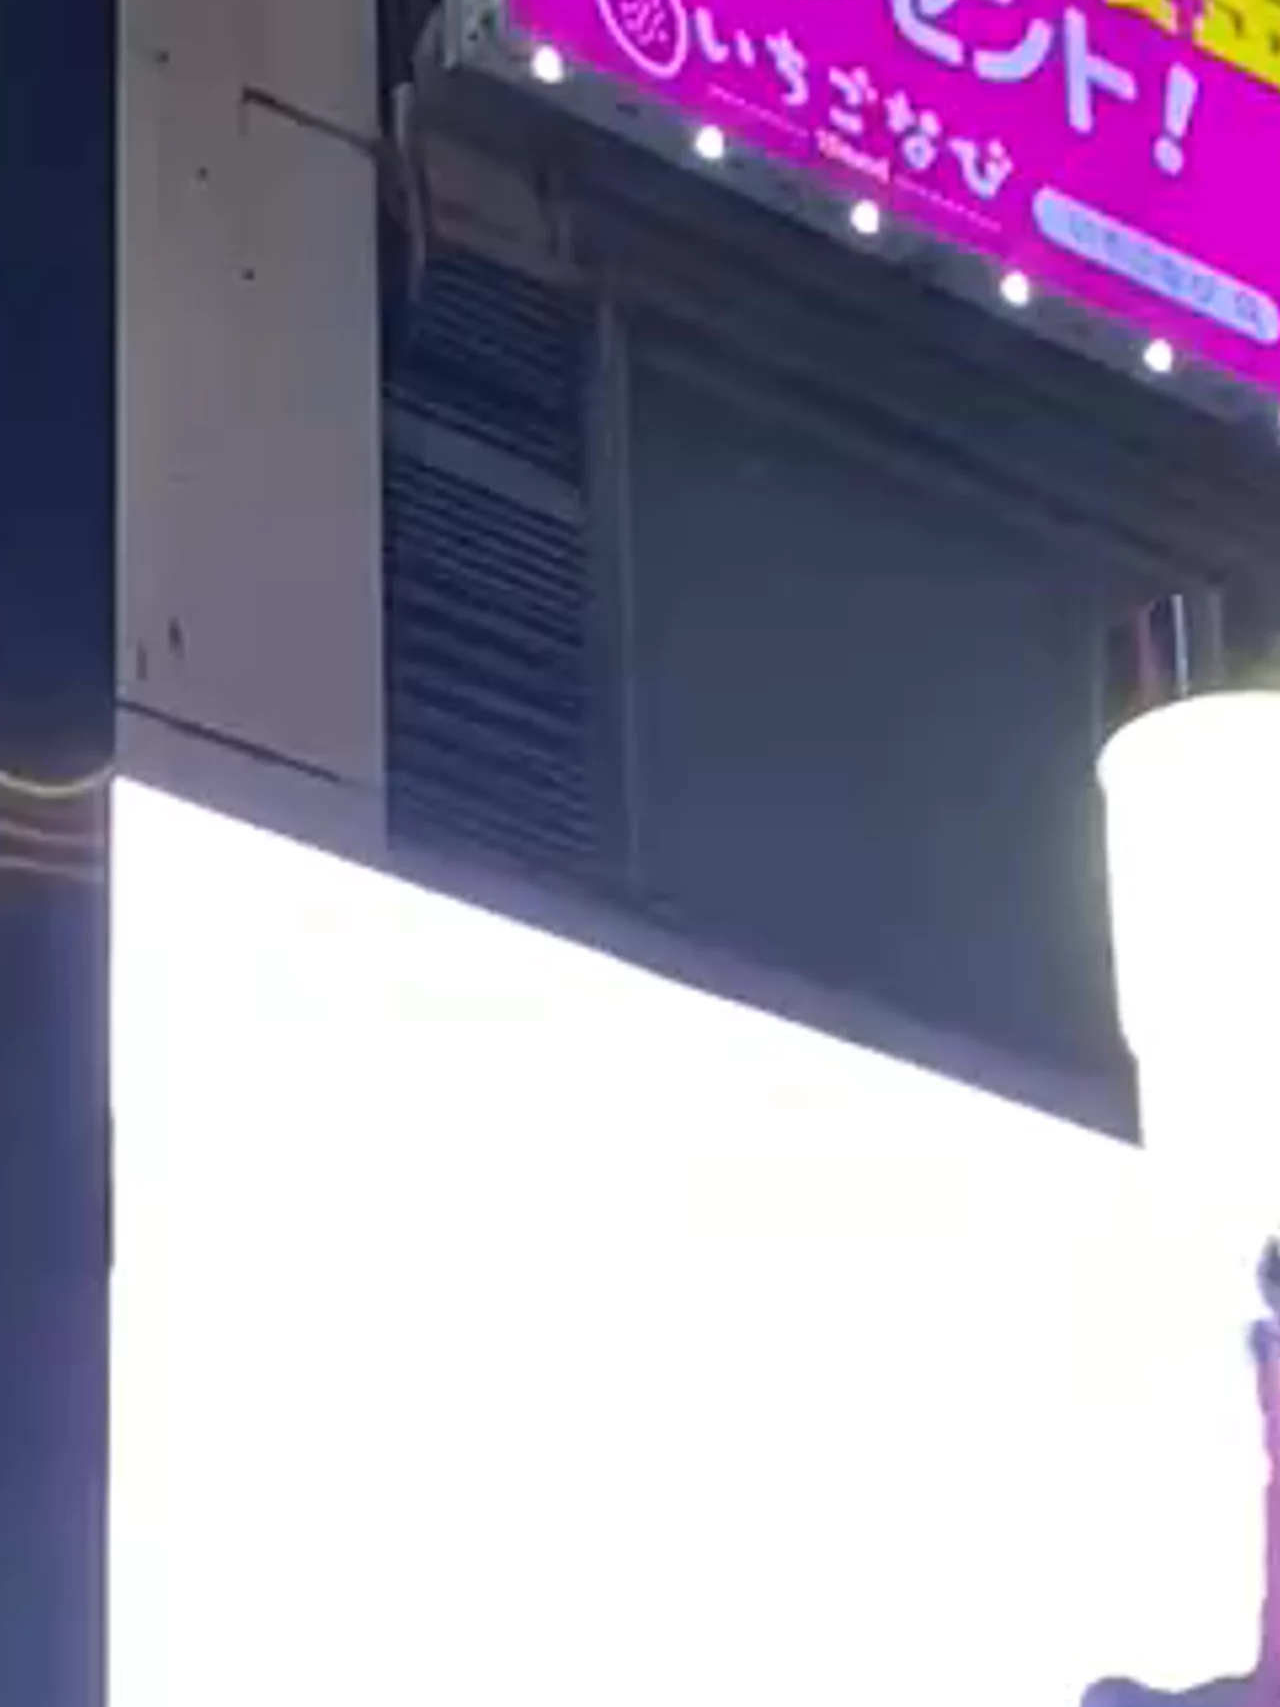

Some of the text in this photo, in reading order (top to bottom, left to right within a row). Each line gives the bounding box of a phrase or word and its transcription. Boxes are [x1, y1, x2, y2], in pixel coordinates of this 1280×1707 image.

[694, 7, 1012, 199] いちごなび
